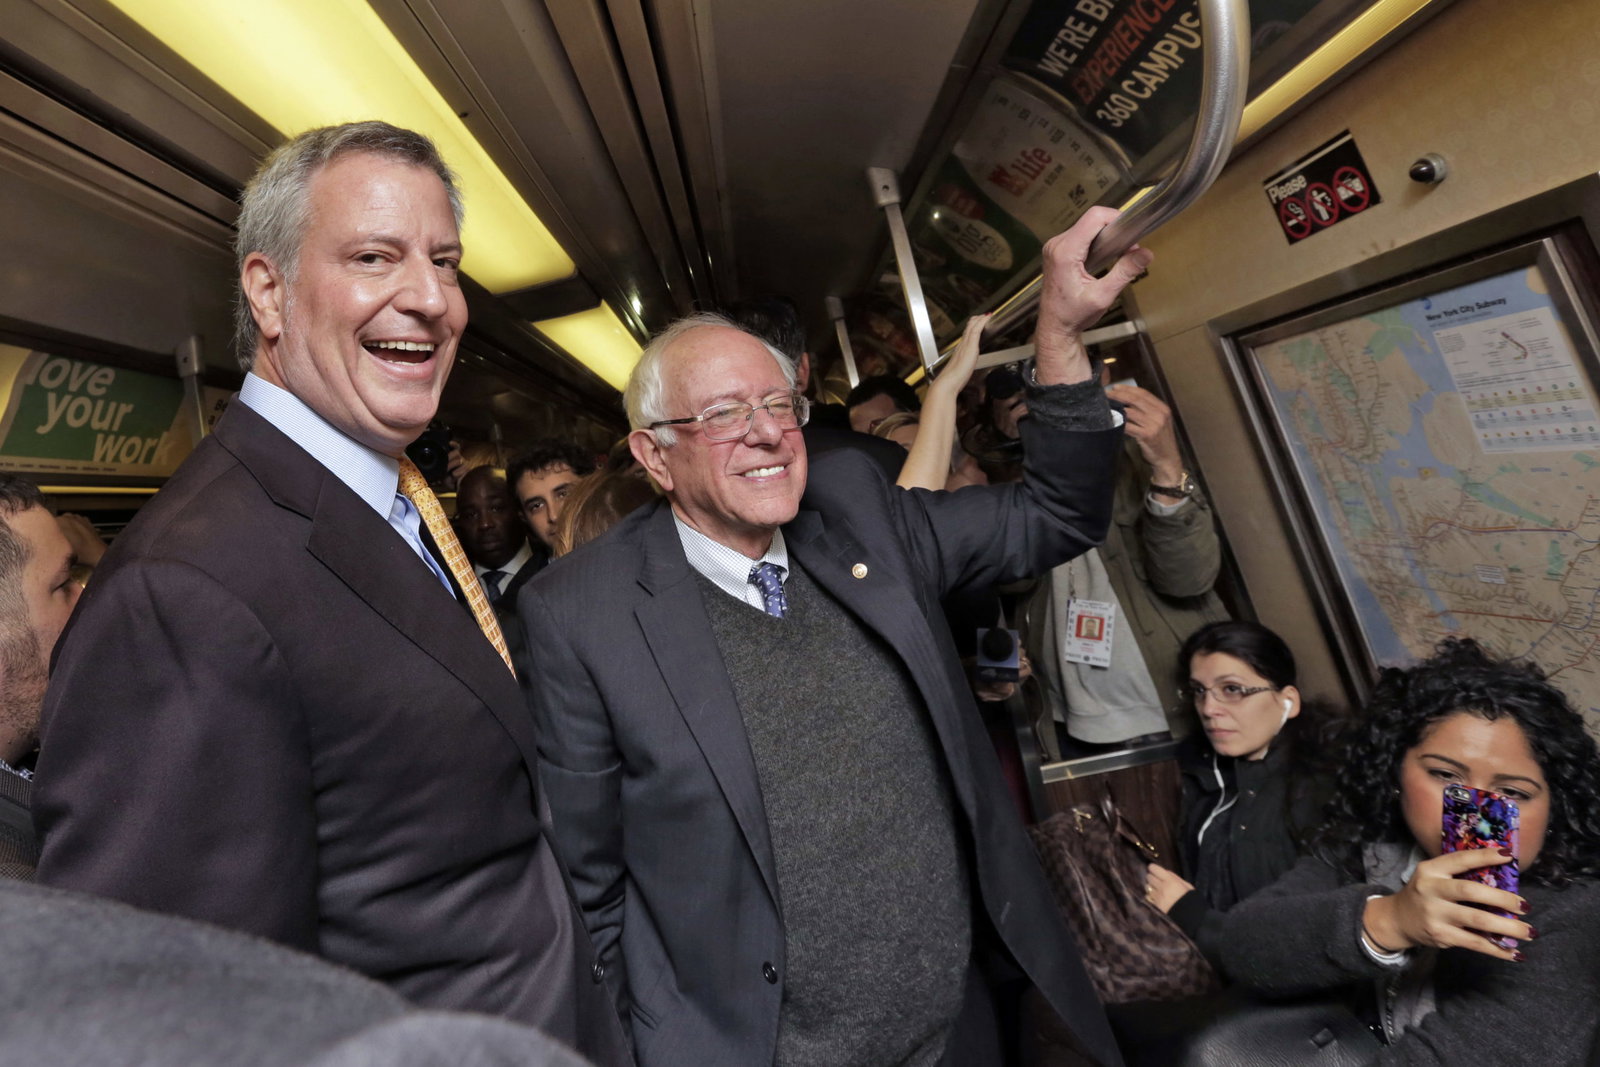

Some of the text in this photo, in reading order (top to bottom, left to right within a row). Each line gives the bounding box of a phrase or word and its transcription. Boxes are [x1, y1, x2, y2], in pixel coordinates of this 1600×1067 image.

[1037, 16, 1098, 77] WE'RE
[1096, 93, 1139, 128] 360
[1011, 147, 1053, 181] life
[1268, 174, 1308, 204] Please
[1425, 313, 1442, 321] New
[1443, 308, 1460, 317] York
[1459, 304, 1475, 314] City
[1475, 297, 1507, 310] Subway
[25, 352, 116, 397] love
[36, 392, 134, 434] your
[92, 431, 171, 464] work
